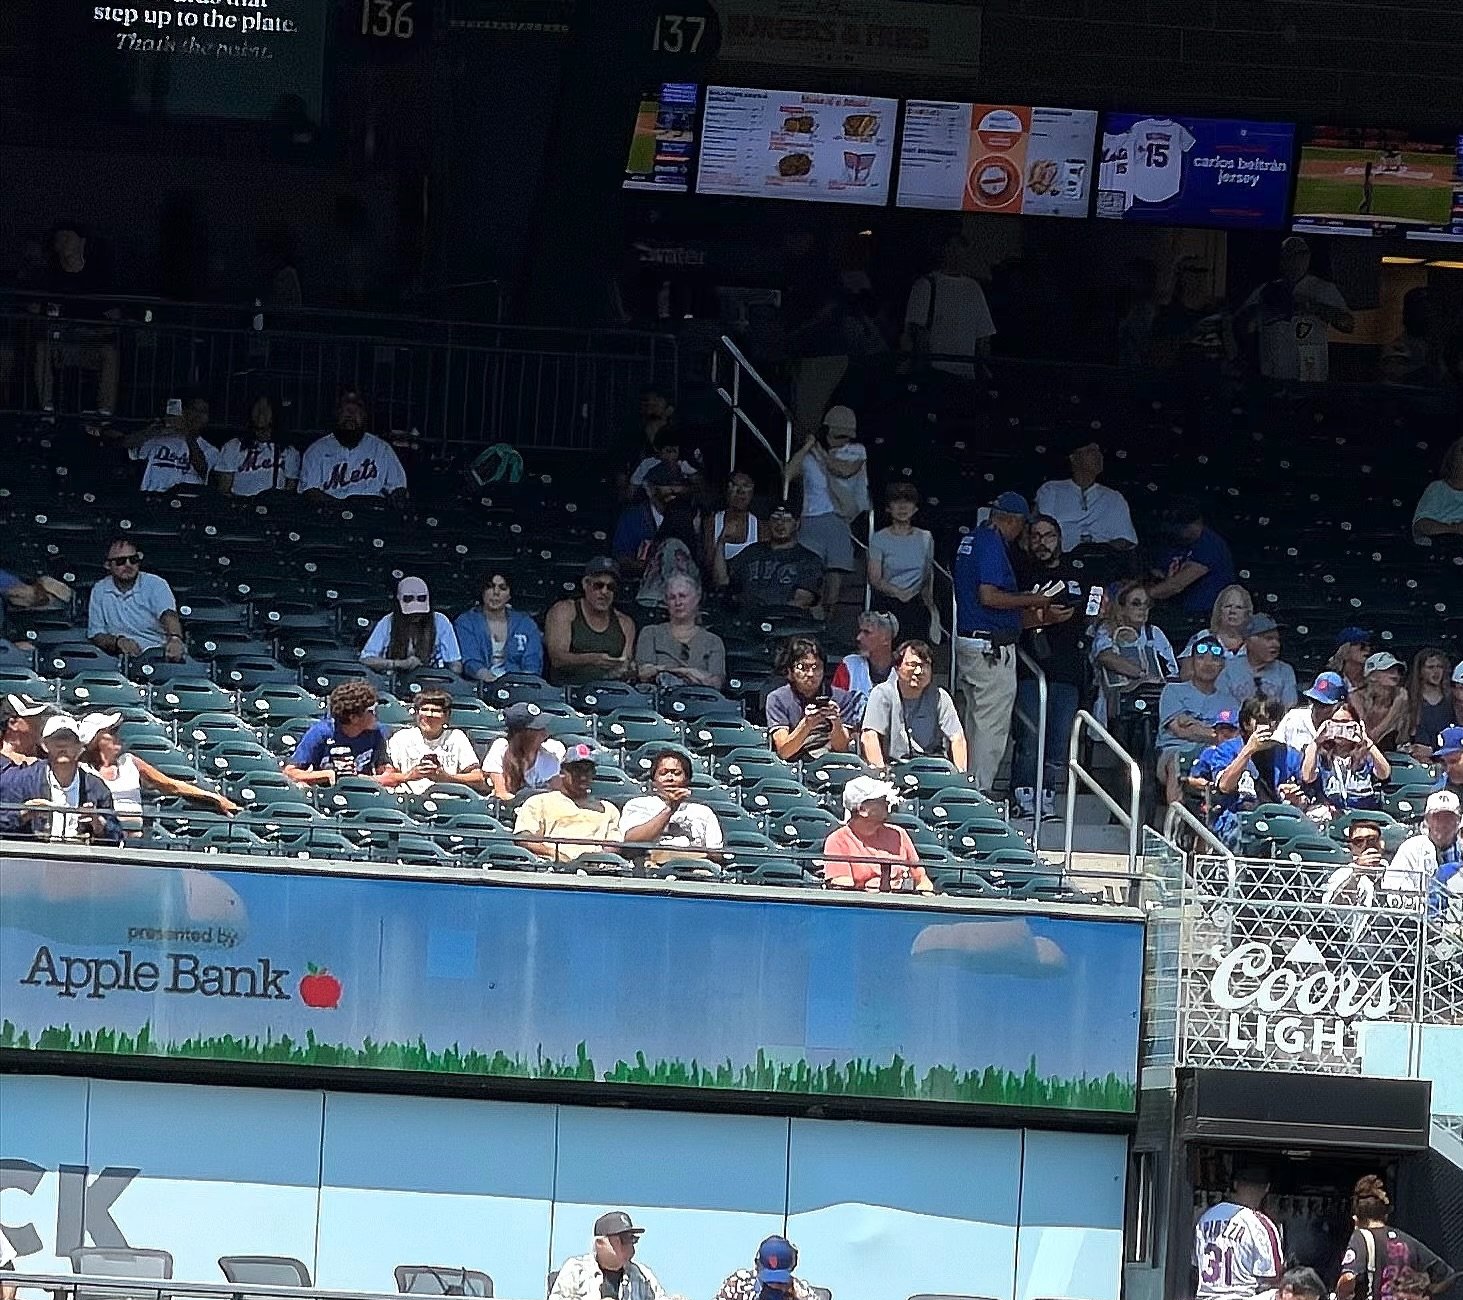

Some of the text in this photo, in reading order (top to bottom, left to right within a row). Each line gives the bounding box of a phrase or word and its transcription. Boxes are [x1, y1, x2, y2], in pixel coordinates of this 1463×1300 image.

[94, 6, 139, 27] step
[145, 9, 172, 28] up
[178, 9, 198, 26] to
[204, 9, 237, 28] the
[360, 0, 415, 39] 136
[650, 15, 705, 53] 137
[1145, 142, 1169, 167] 15
[1193, 155, 1234, 169] carlos
[1217, 169, 1261, 187] jersey
[238, 448, 286, 474] Mes
[323, 458, 378, 491] Mets
[128, 925, 240, 950] presented by
[20, 945, 292, 1000] Apple Bank
[1209, 941, 1398, 1020] Coors
[1201, 1242, 1234, 1287] 31
